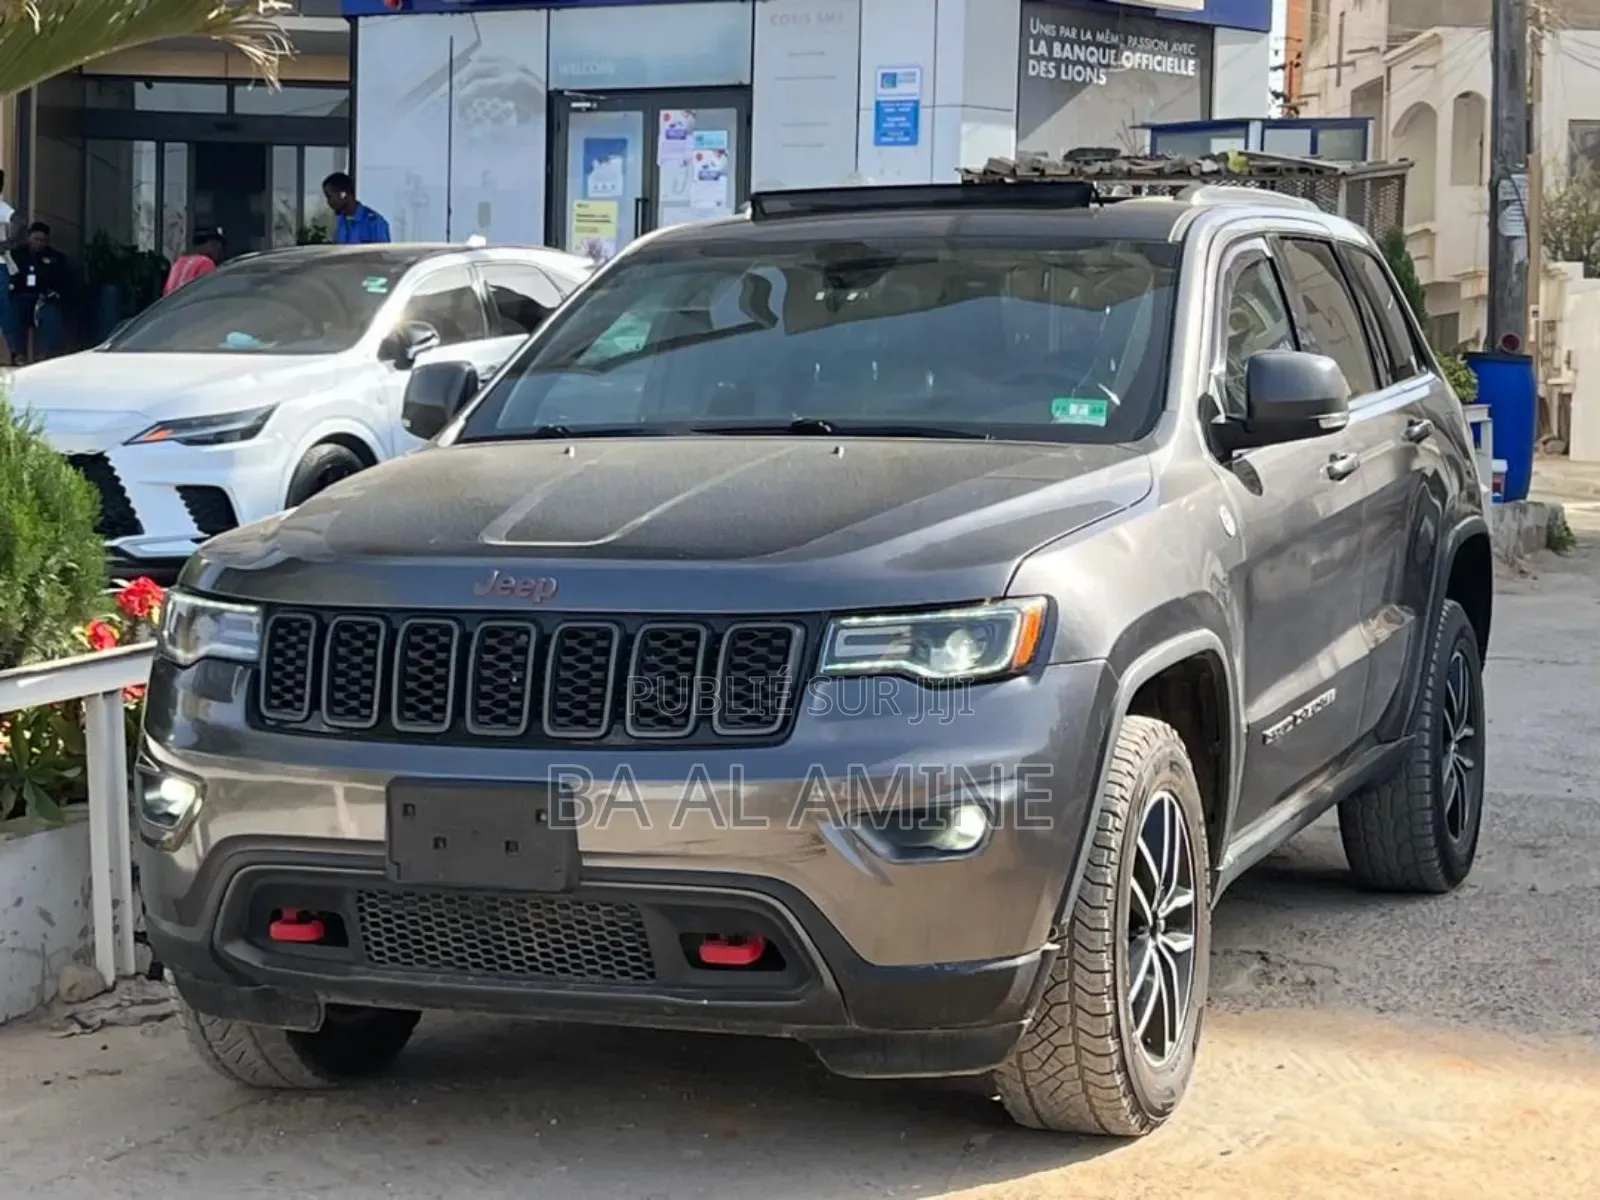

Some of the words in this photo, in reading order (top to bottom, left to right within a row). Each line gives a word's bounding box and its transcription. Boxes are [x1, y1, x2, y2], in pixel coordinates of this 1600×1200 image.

[1029, 17, 1056, 37] UNIS
[1059, 25, 1077, 40] PAR
[1081, 28, 1093, 42] LA
[1127, 34, 1169, 52] PASSION
[1170, 42, 1196, 55] AVEC
[1028, 38, 1048, 57] LA
[1053, 41, 1117, 66] BANQUE
[1121, 51, 1196, 76] OFFICIELLE
[1028, 59, 1056, 77] DES
[1060, 65, 1108, 86] LIONS
[473, 567, 558, 605] Jeep
